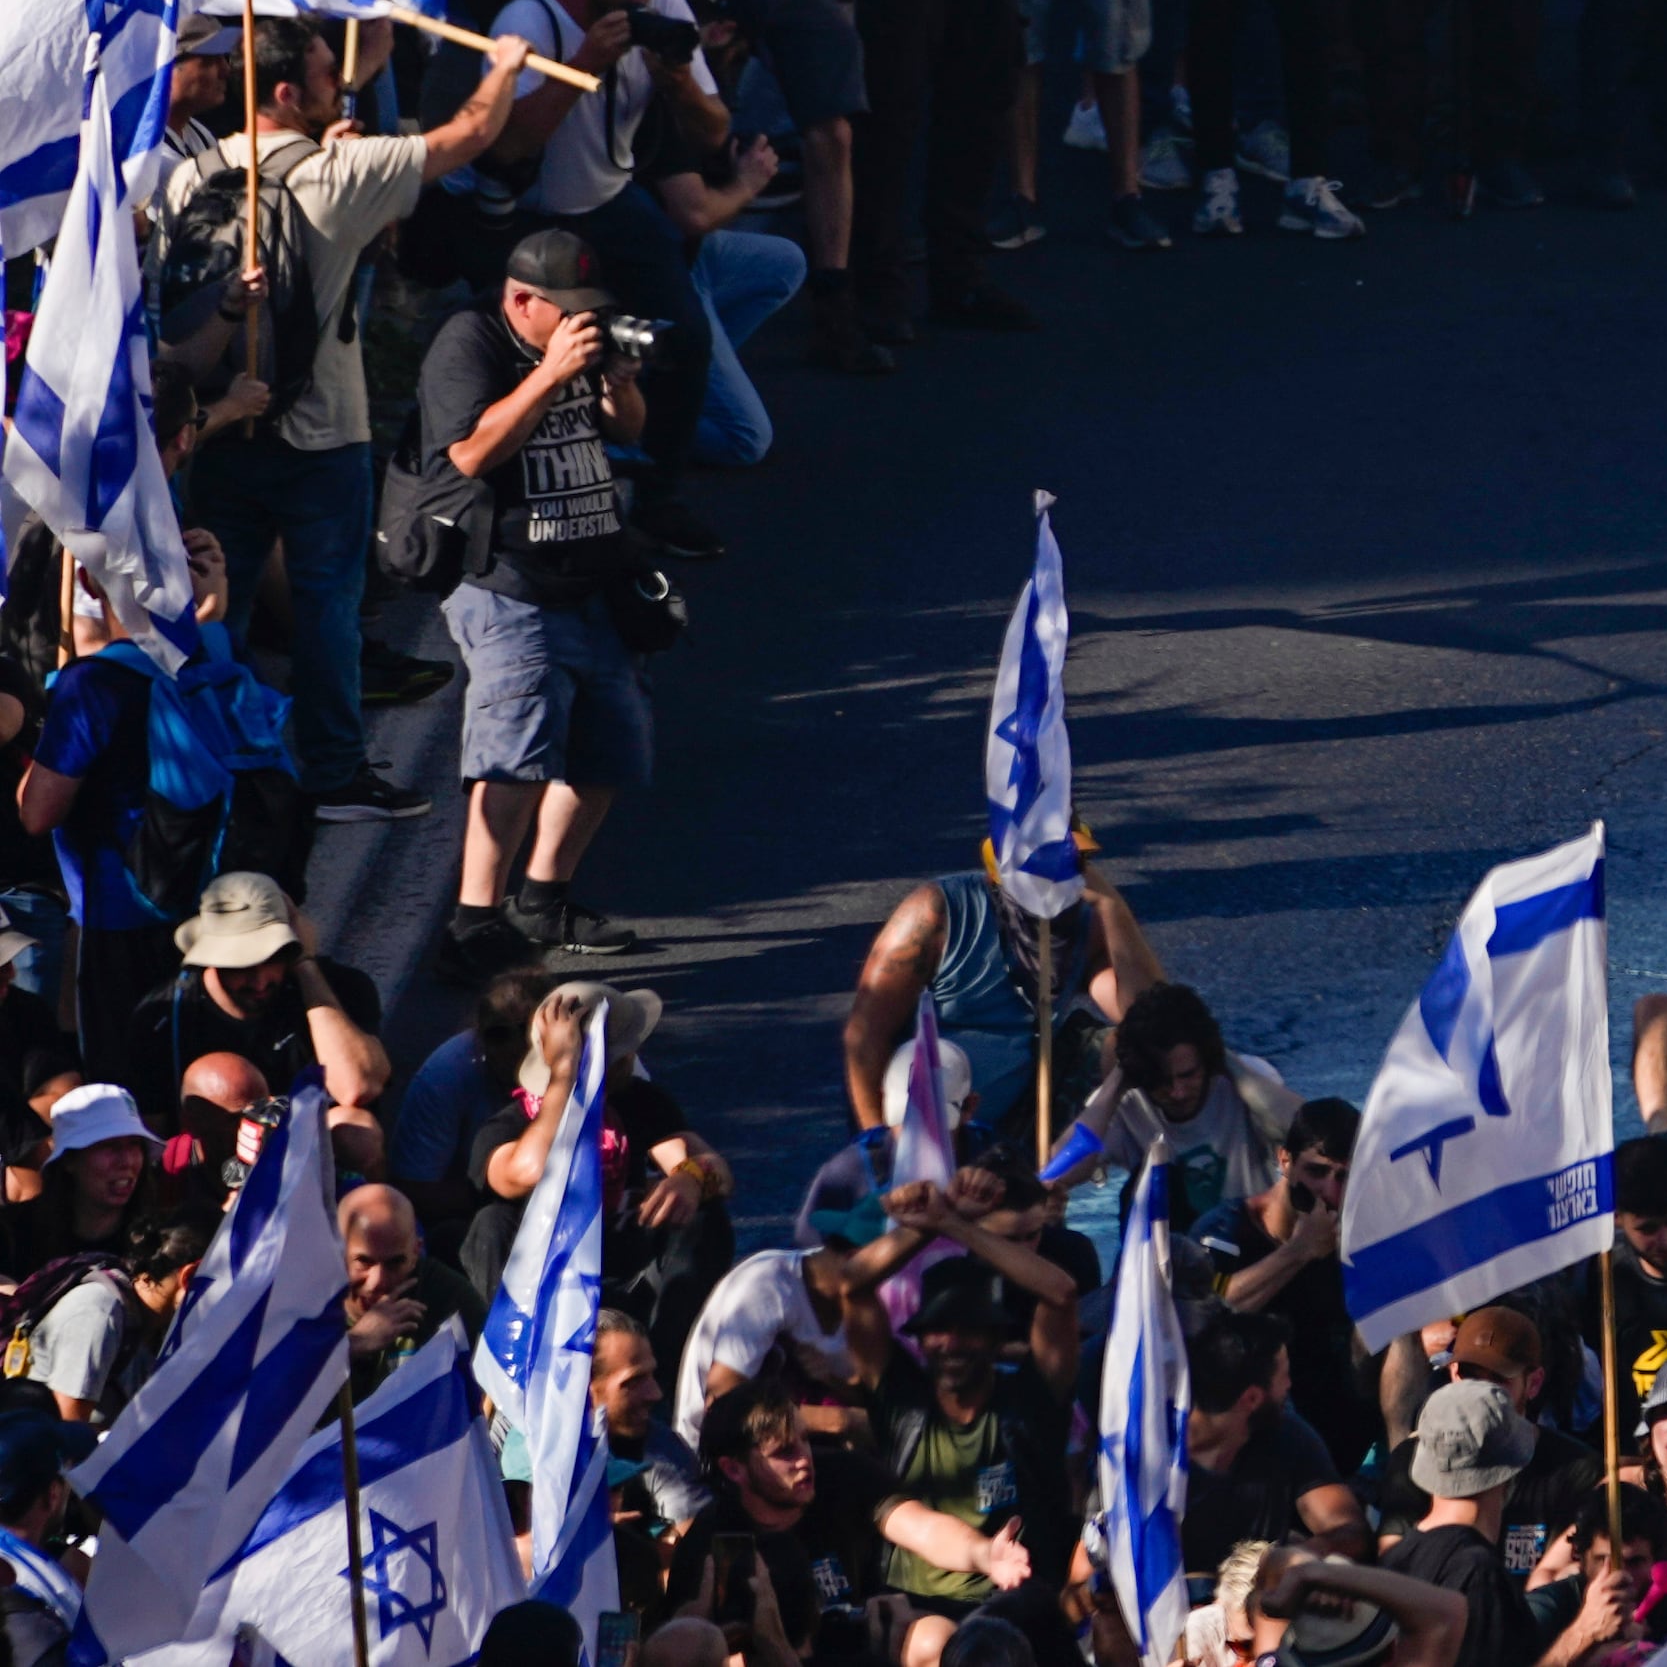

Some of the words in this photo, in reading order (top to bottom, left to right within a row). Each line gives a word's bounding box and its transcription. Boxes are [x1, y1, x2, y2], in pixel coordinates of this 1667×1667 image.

[528, 439, 613, 493] THIN
[531, 498, 564, 519] YOU
[1545, 1162, 1596, 1201] חופשי
[1548, 1188, 1598, 1231] בארצנו
